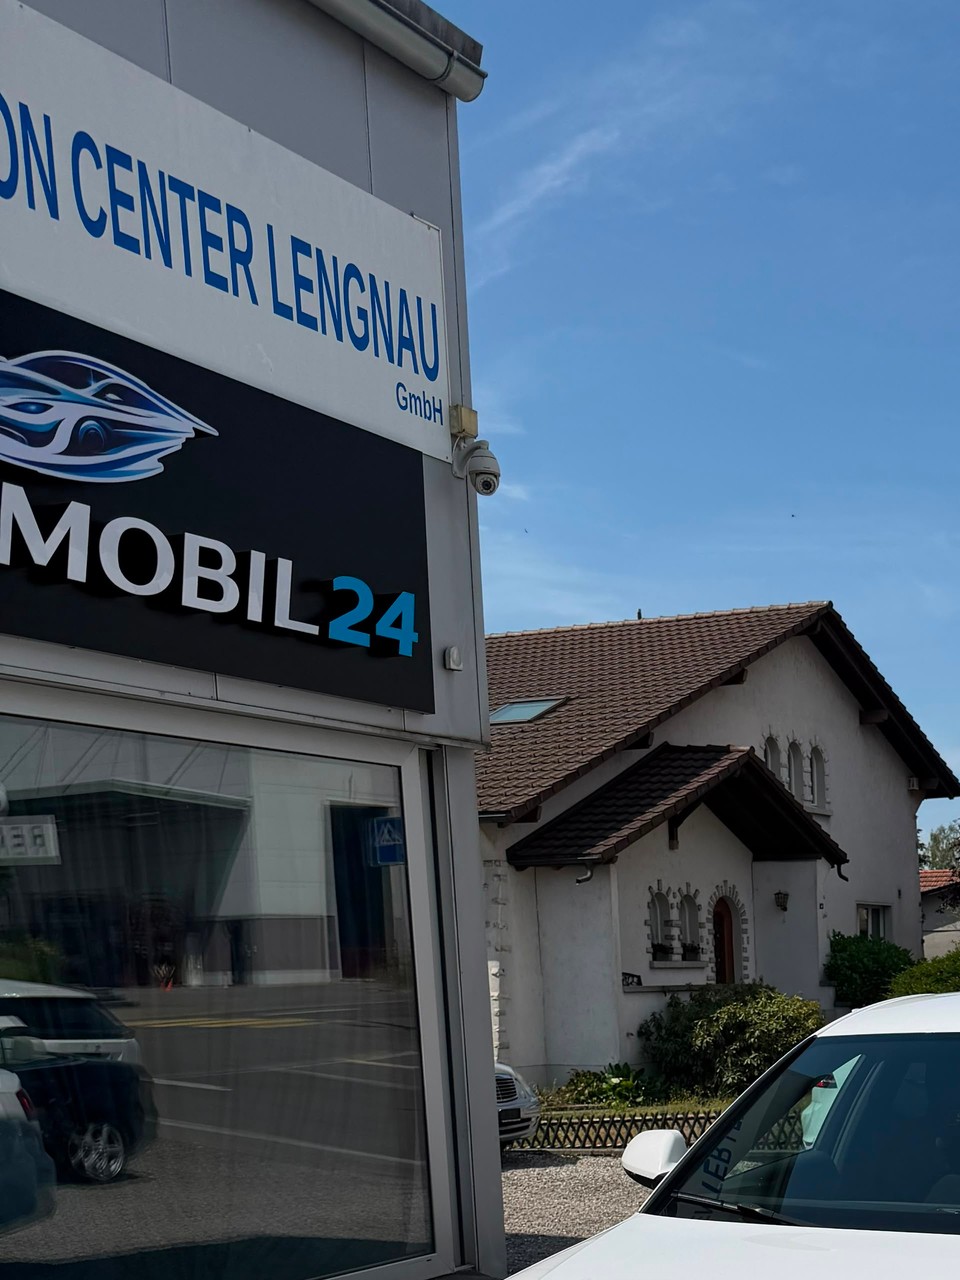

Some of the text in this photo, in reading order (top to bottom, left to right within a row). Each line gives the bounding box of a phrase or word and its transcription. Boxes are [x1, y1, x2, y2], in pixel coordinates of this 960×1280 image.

[72, 130, 258, 305] CENTER
[267, 223, 440, 382] LENGNAU
[396, 382, 443, 426] GmbH
